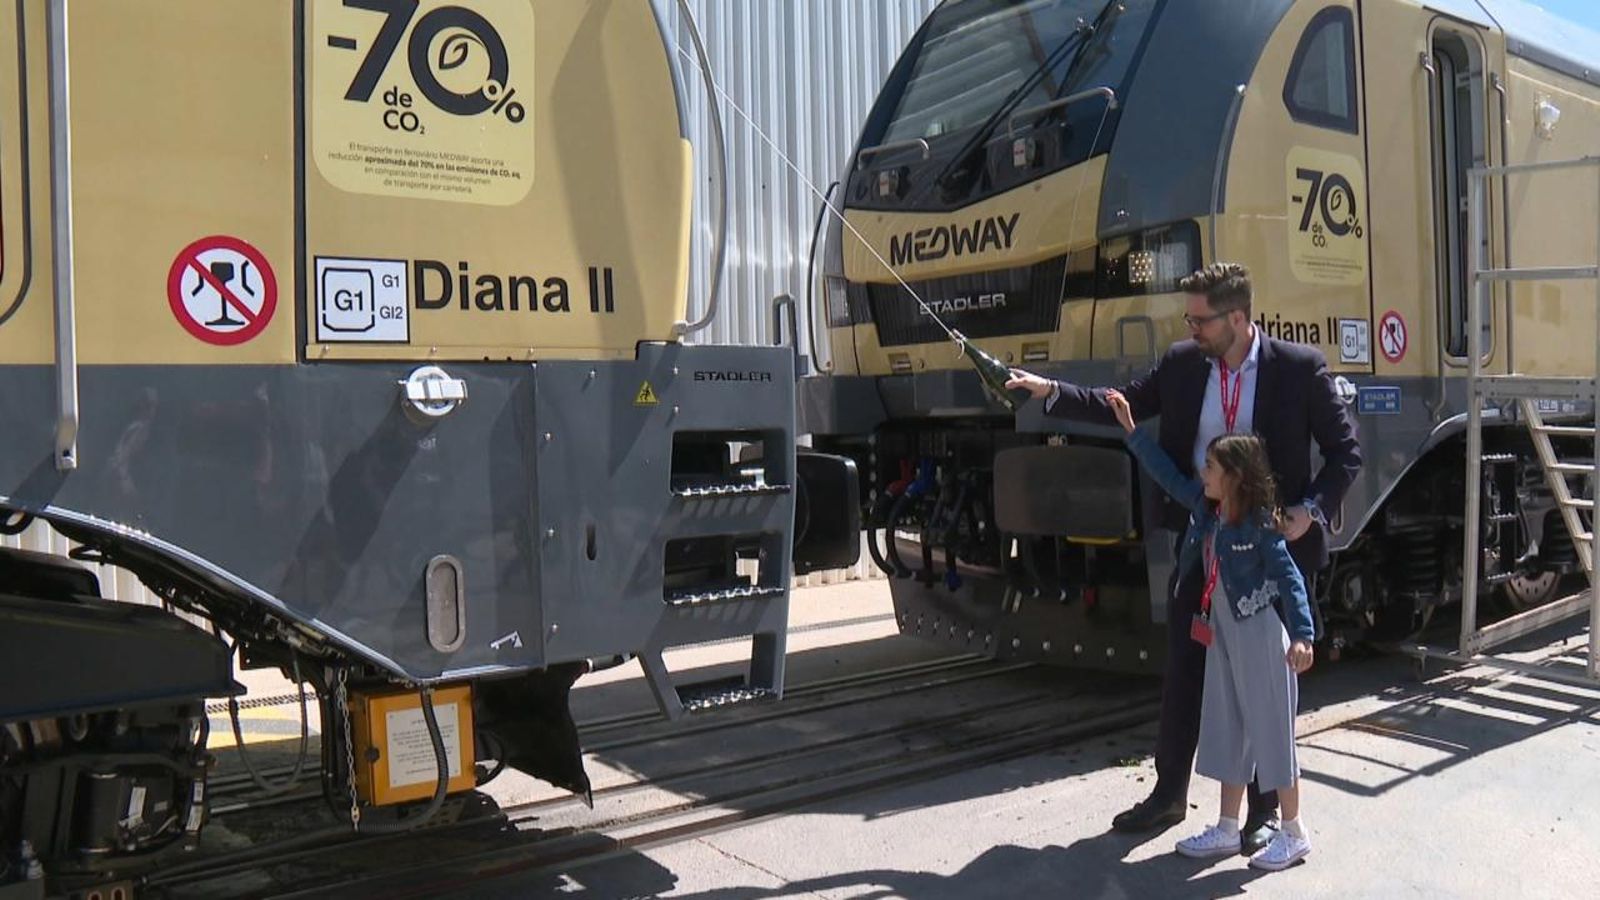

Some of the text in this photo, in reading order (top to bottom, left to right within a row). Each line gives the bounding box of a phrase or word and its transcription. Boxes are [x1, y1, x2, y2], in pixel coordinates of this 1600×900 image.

[383, 85, 413, 108] de
[356, 143, 393, 155] transporte
[393, 180, 429, 190] transporte
[1291, 167, 1363, 239] -70%
[1311, 221, 1323, 234] de
[890, 212, 1020, 268] MEDWAY
[382, 274, 400, 288] G1
[414, 259, 615, 313] Diana II
[334, 289, 364, 312] G1
[919, 292, 1007, 315] STADLER
[1253, 312, 1320, 344] driana
[693, 370, 772, 382] STADLER
